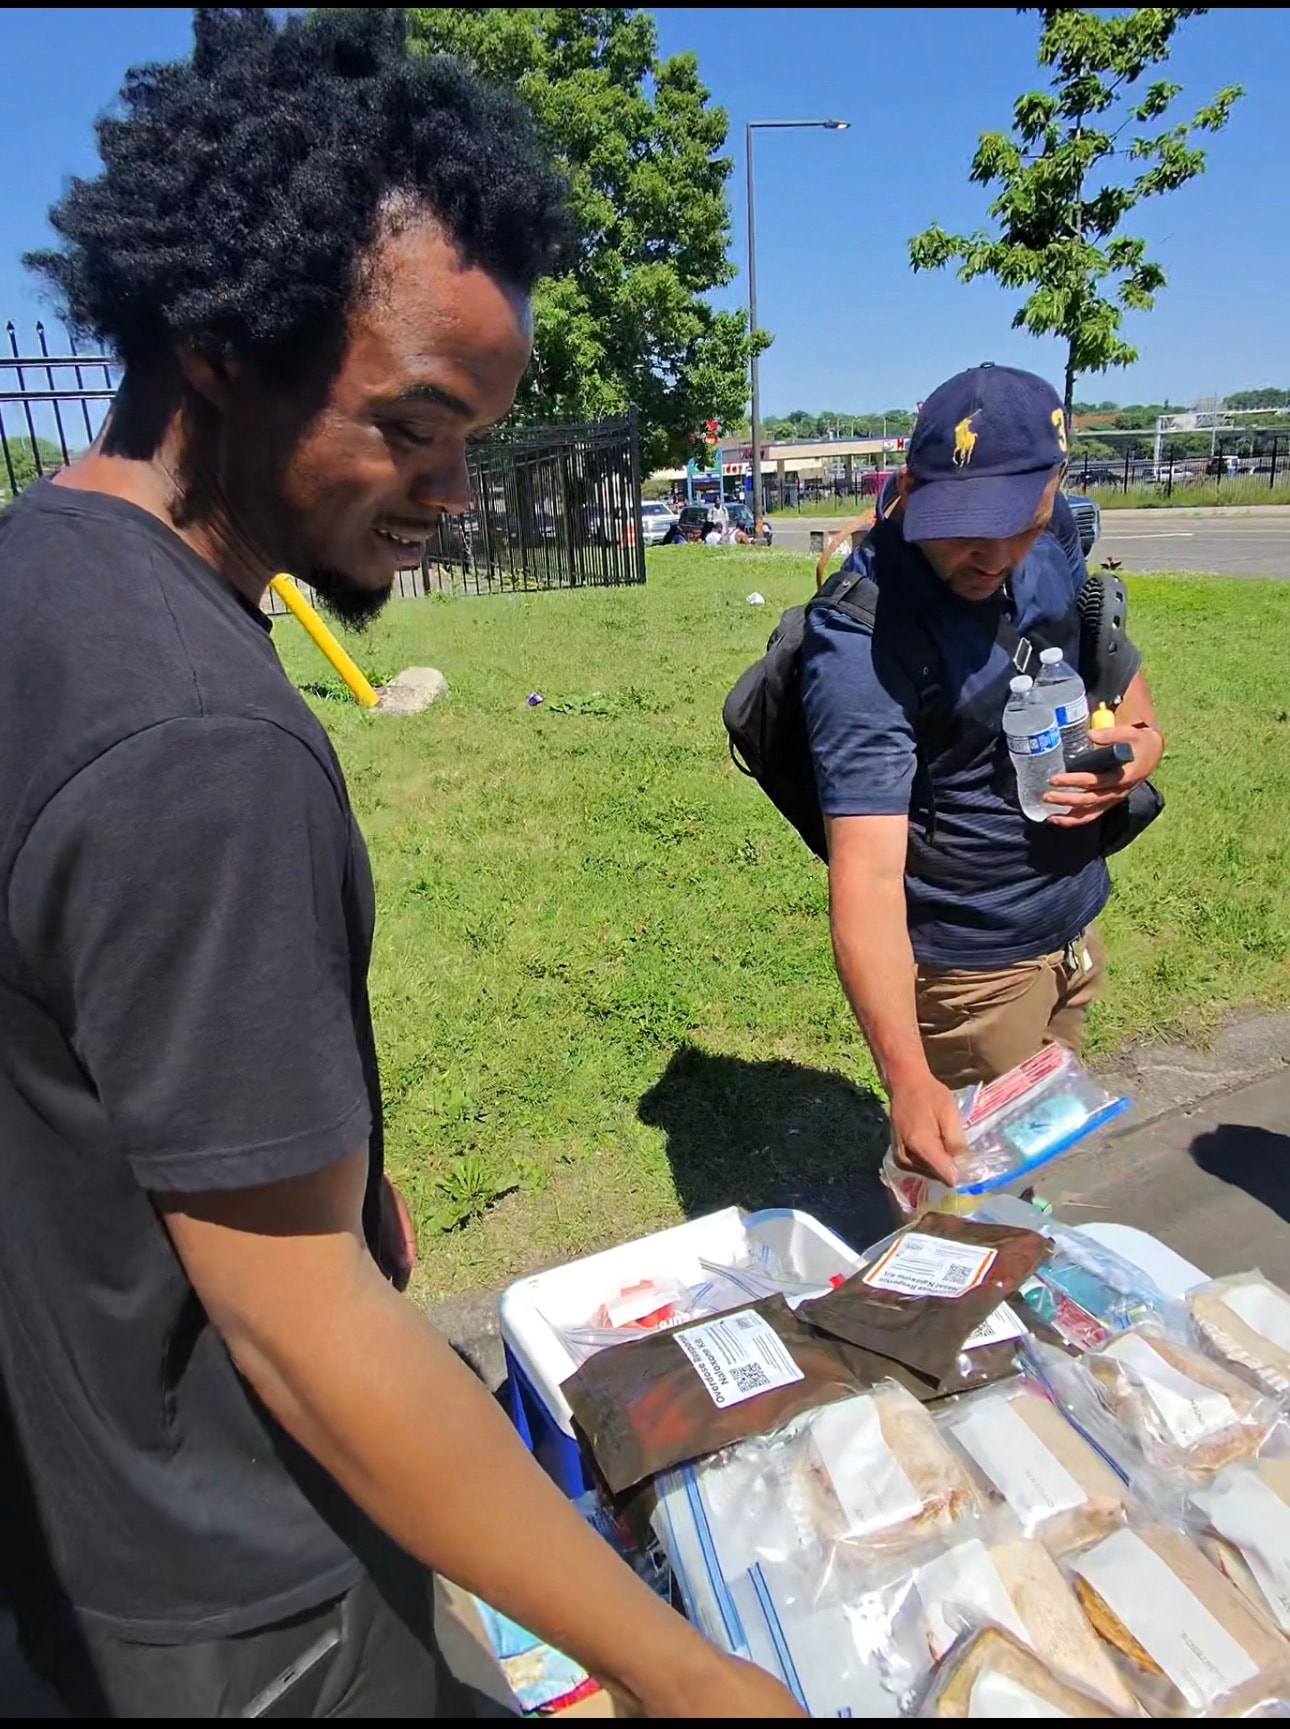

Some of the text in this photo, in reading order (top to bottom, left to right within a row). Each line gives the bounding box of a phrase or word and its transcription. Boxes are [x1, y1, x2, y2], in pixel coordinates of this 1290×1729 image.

[694, 1337, 706, 1350] Kit
[697, 1361, 726, 1404] Overdose
[702, 1348, 730, 1386] Naloxone
